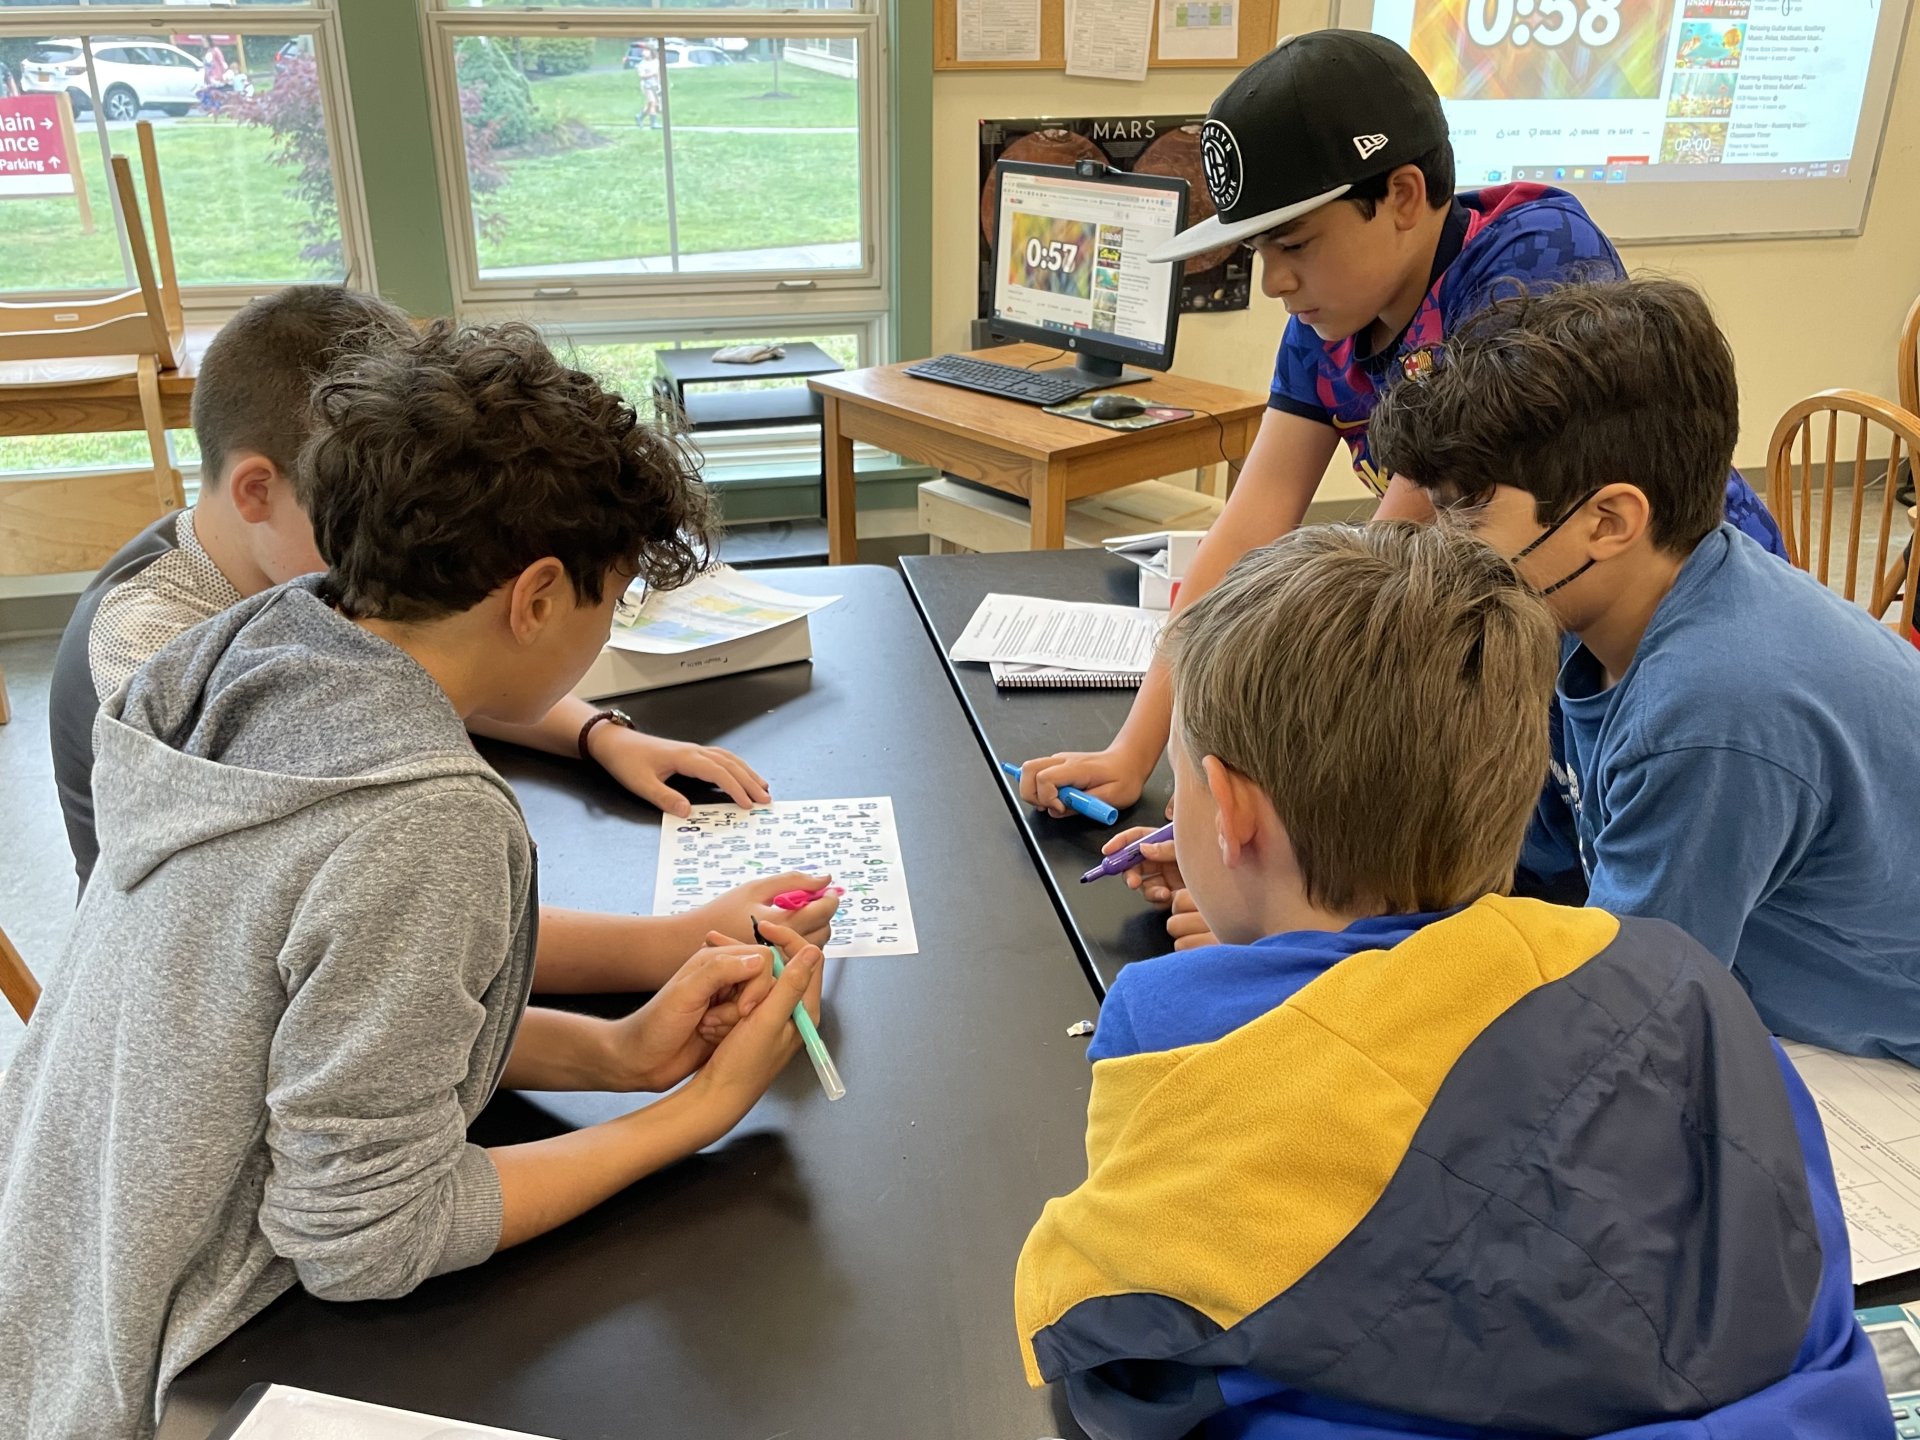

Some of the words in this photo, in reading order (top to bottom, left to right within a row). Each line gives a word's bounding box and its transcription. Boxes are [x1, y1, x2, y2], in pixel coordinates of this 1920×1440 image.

[1467, 0, 1621, 46] 0:58
[1093, 119, 1156, 140] MARS
[0, 157, 44, 172] Parking
[1027, 238, 1079, 273] 0:57
[861, 898, 880, 912] 86
